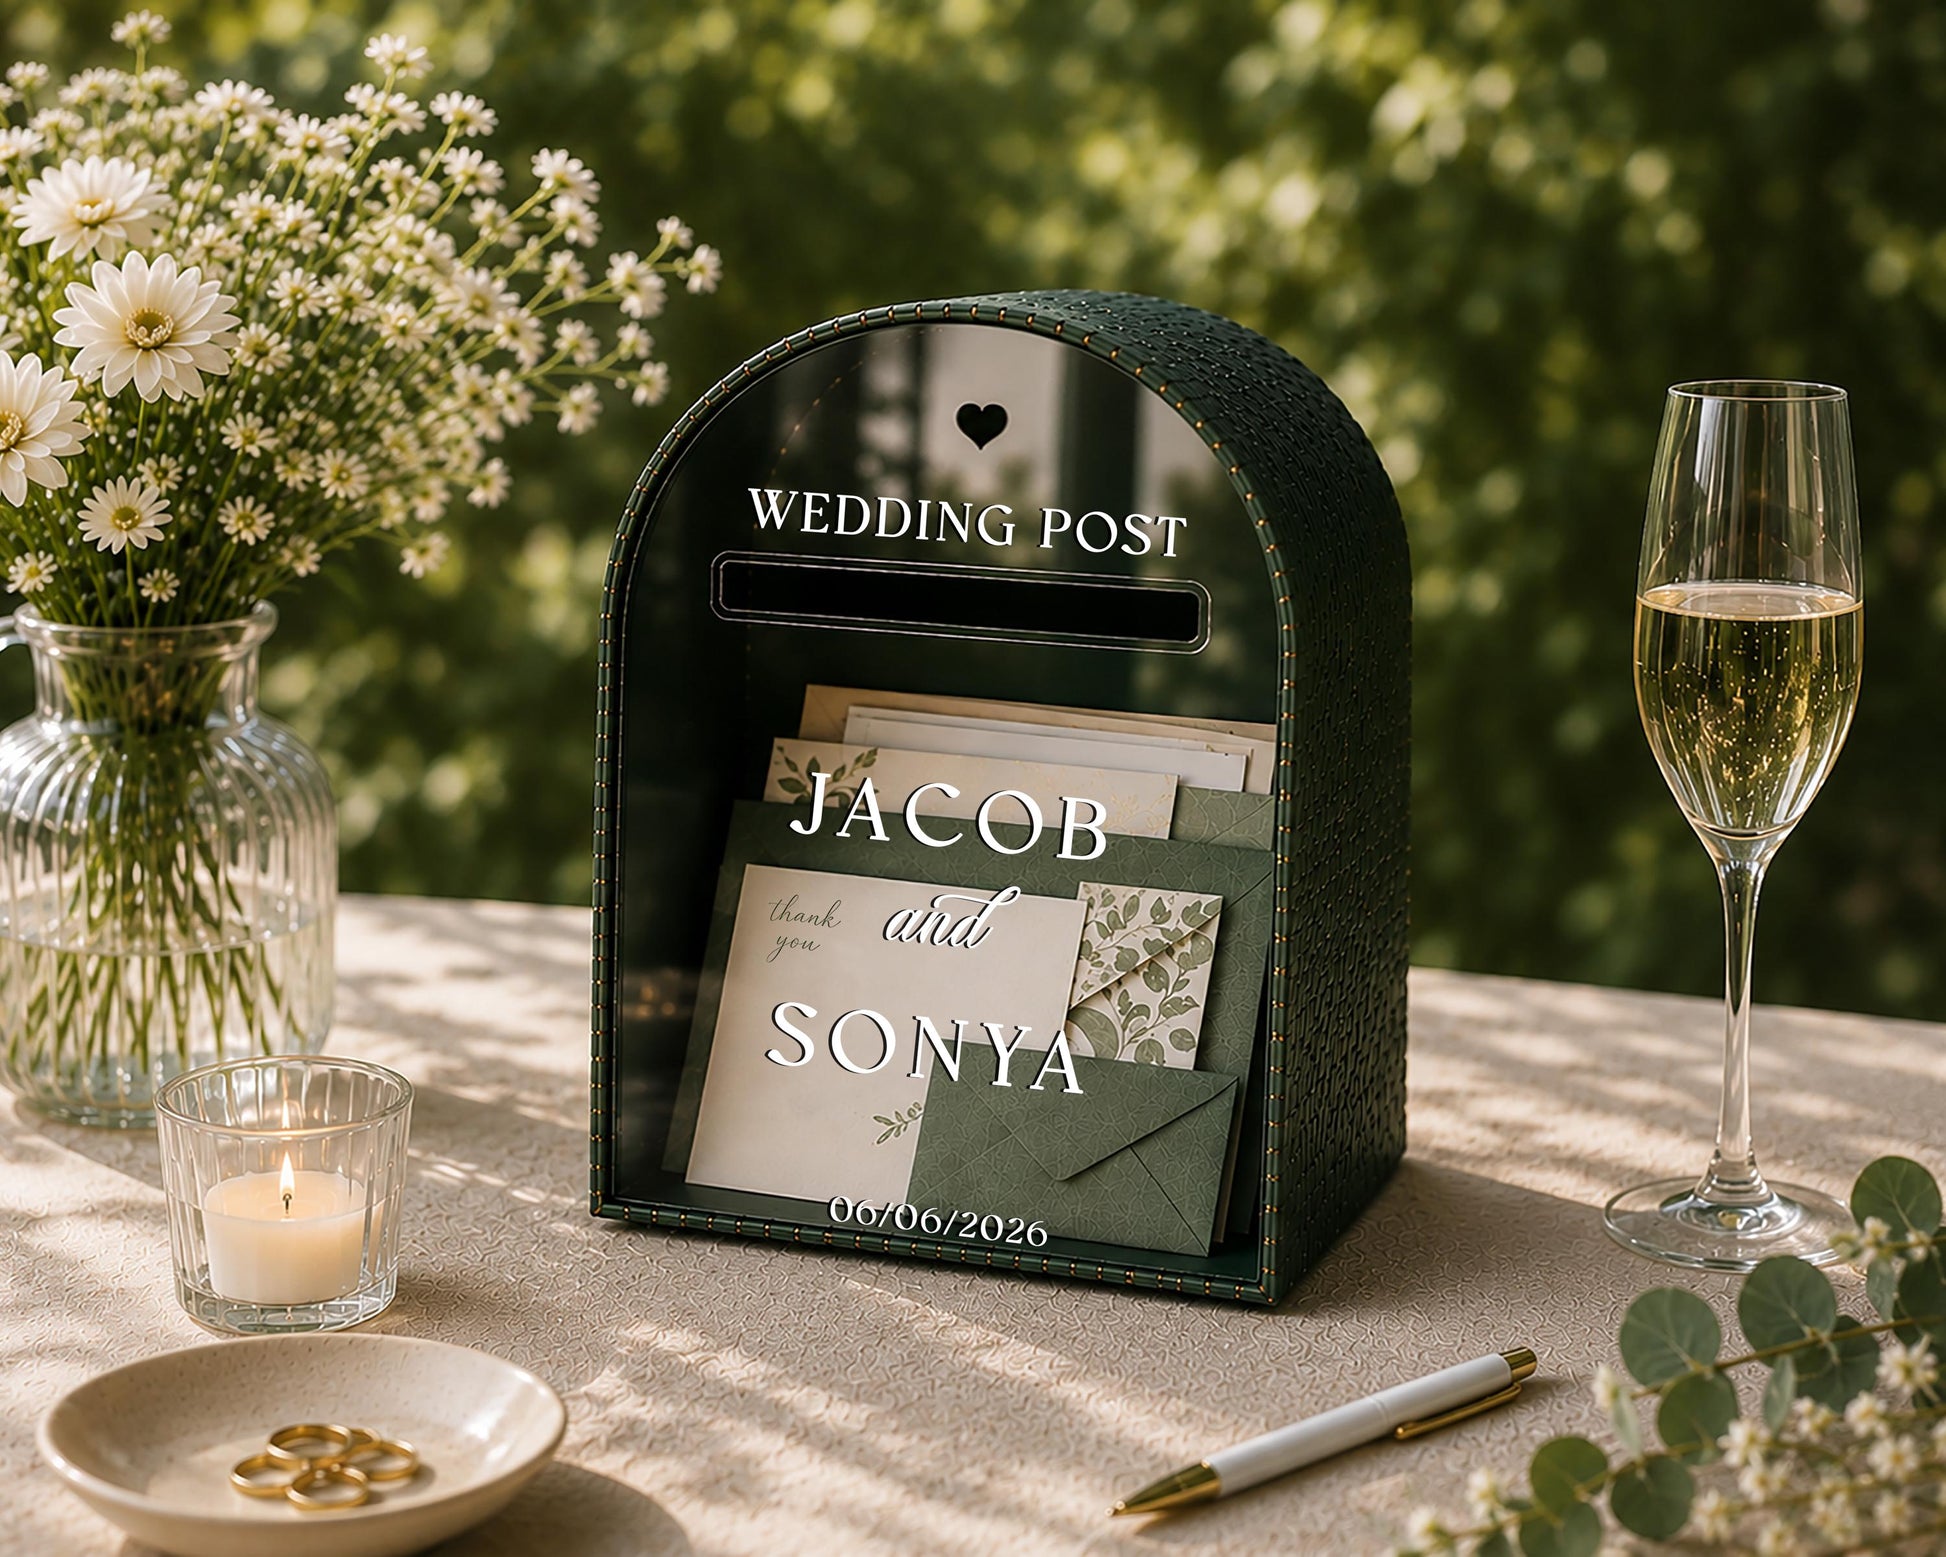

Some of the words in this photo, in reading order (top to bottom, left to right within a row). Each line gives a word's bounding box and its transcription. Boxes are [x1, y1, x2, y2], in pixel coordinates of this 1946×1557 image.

[748, 488, 1016, 546] WEDDING
[1039, 507, 1187, 557] POST
[790, 772, 1108, 861] JACOB
[768, 894, 842, 928] thank
[882, 886, 1021, 949] and
[766, 935, 821, 963] you
[765, 1001, 1083, 1095] SONYA
[828, 1196, 1049, 1247] 06/06/2026
